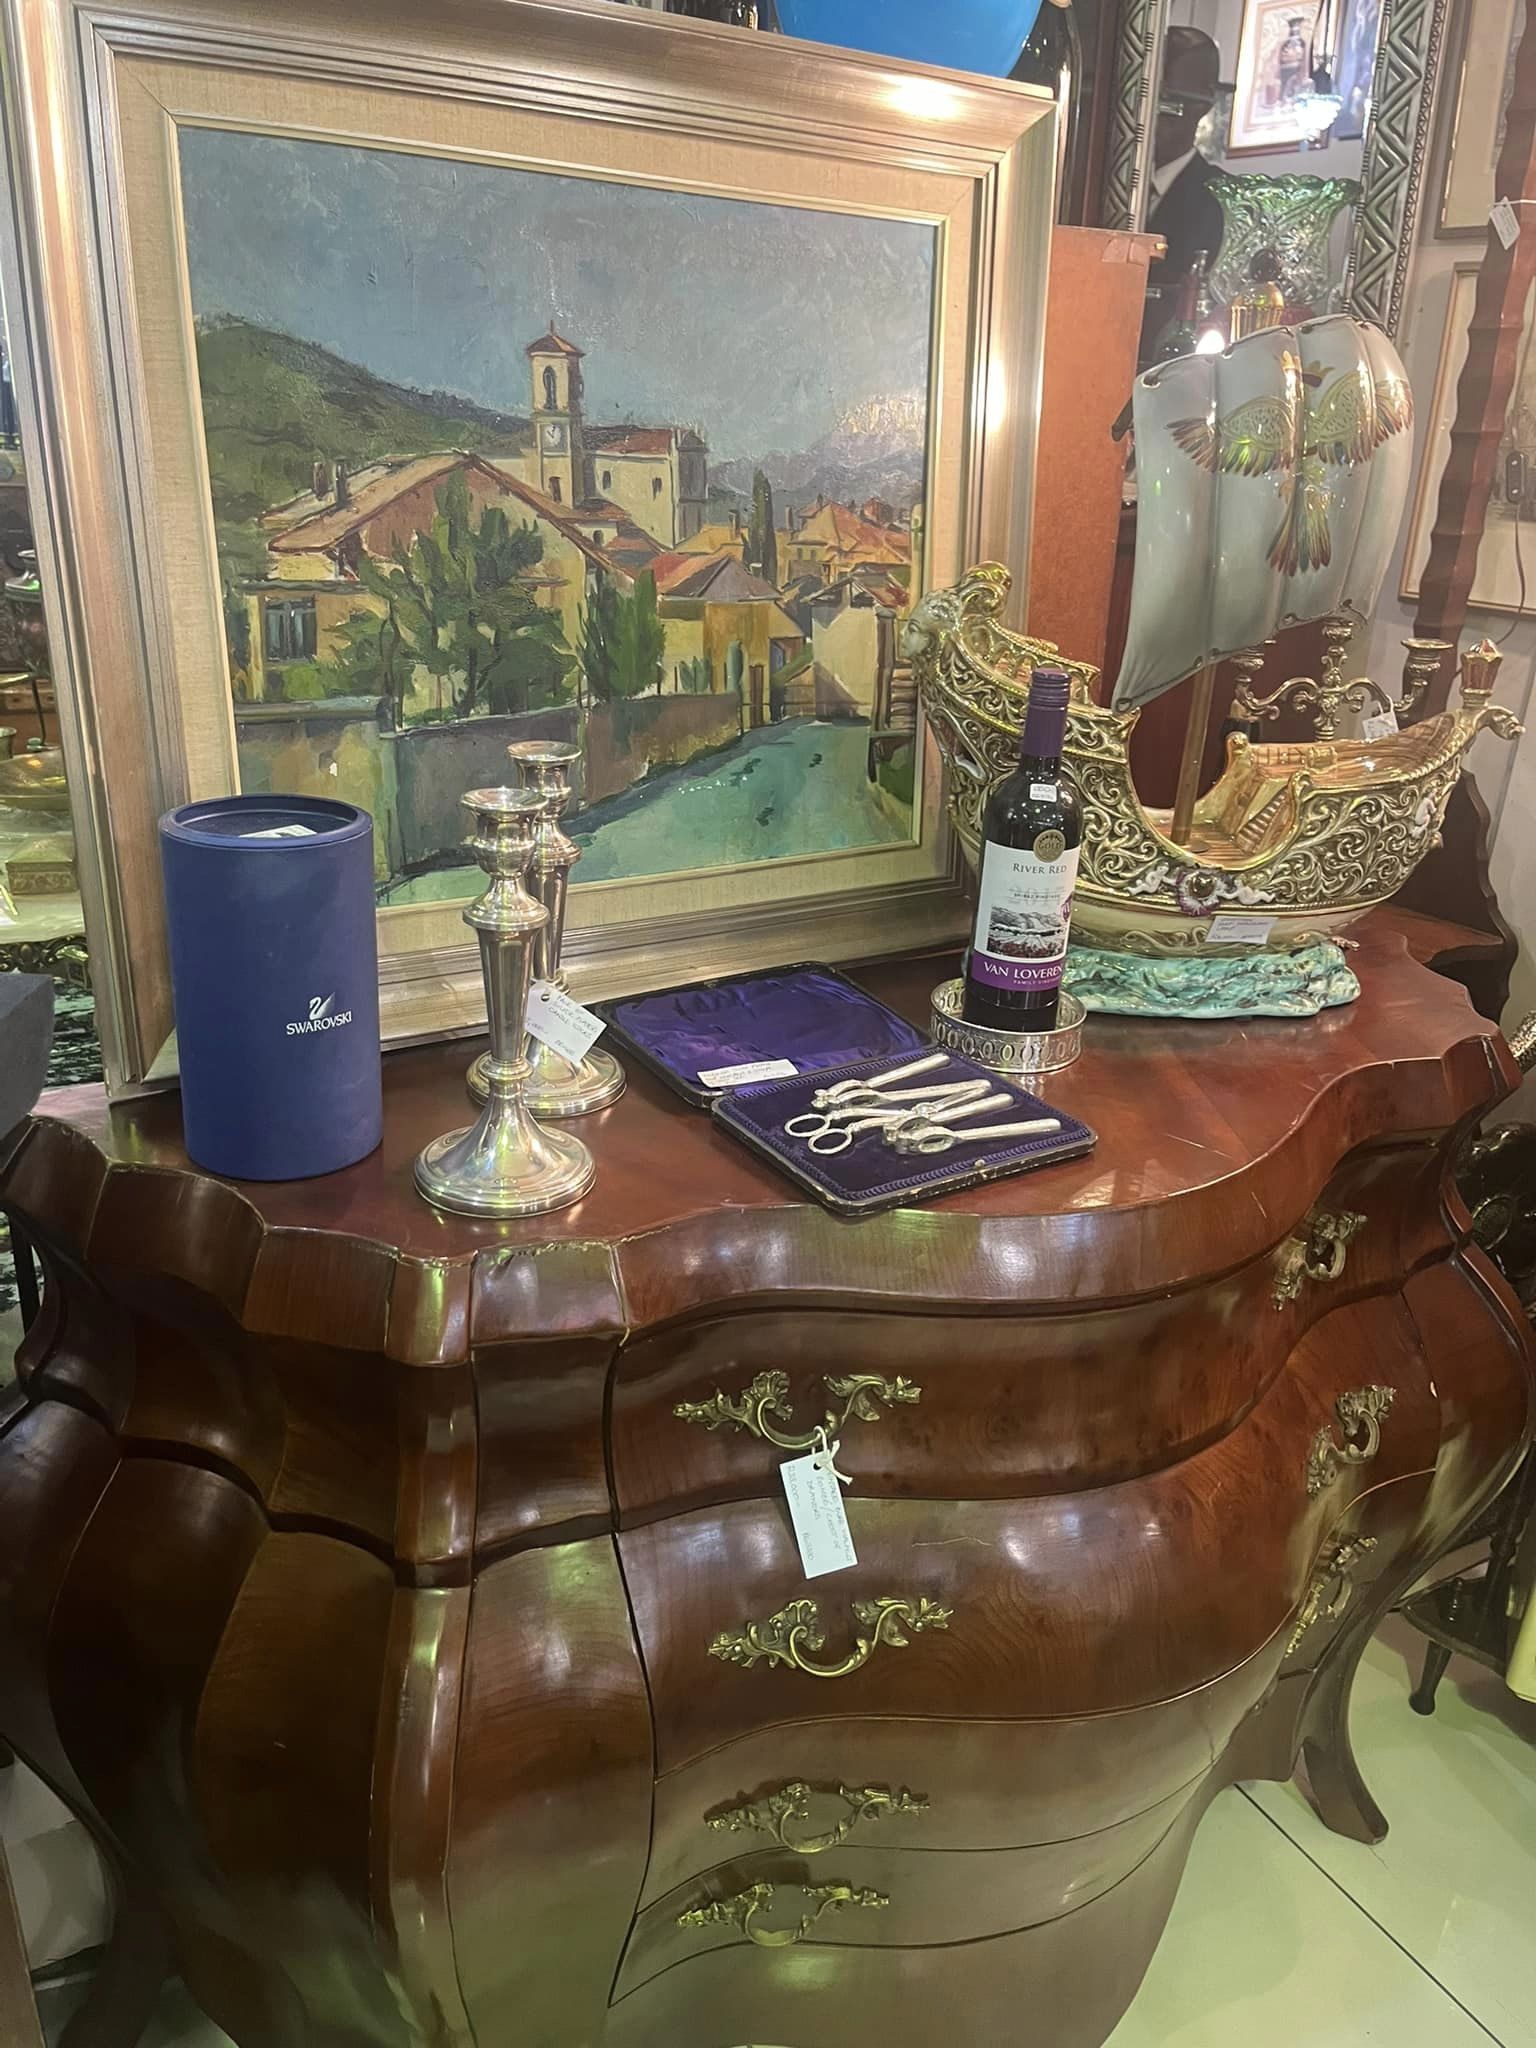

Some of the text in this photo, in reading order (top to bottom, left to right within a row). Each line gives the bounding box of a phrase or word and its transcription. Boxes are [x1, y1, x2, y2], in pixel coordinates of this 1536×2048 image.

[1013, 863, 1067, 874] RIVER RED
[984, 961, 1063, 979] VAN LOVEREN
[286, 1011, 352, 1035] SWAROVSKI
